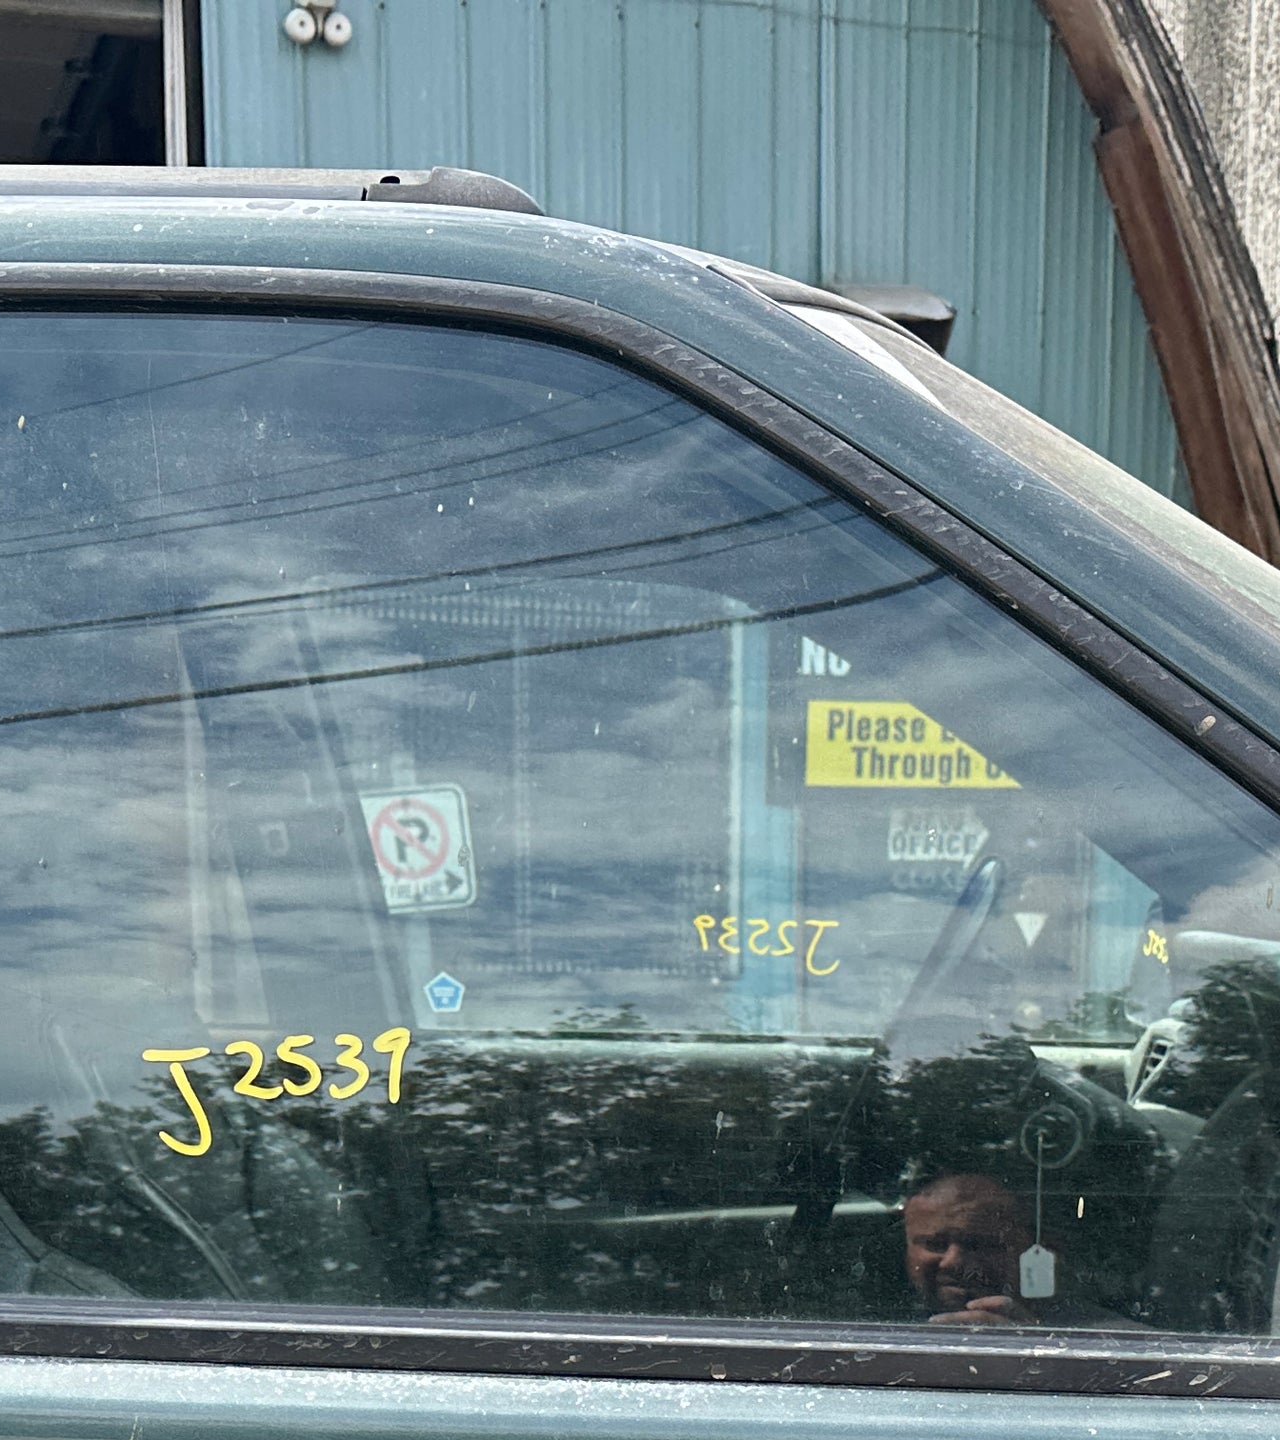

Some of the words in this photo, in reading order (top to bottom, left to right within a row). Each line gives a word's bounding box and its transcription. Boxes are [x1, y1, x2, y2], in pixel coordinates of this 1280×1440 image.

[827, 709, 926, 743] Please
[851, 746, 970, 784] Through
[142, 1027, 412, 1156] J2539
